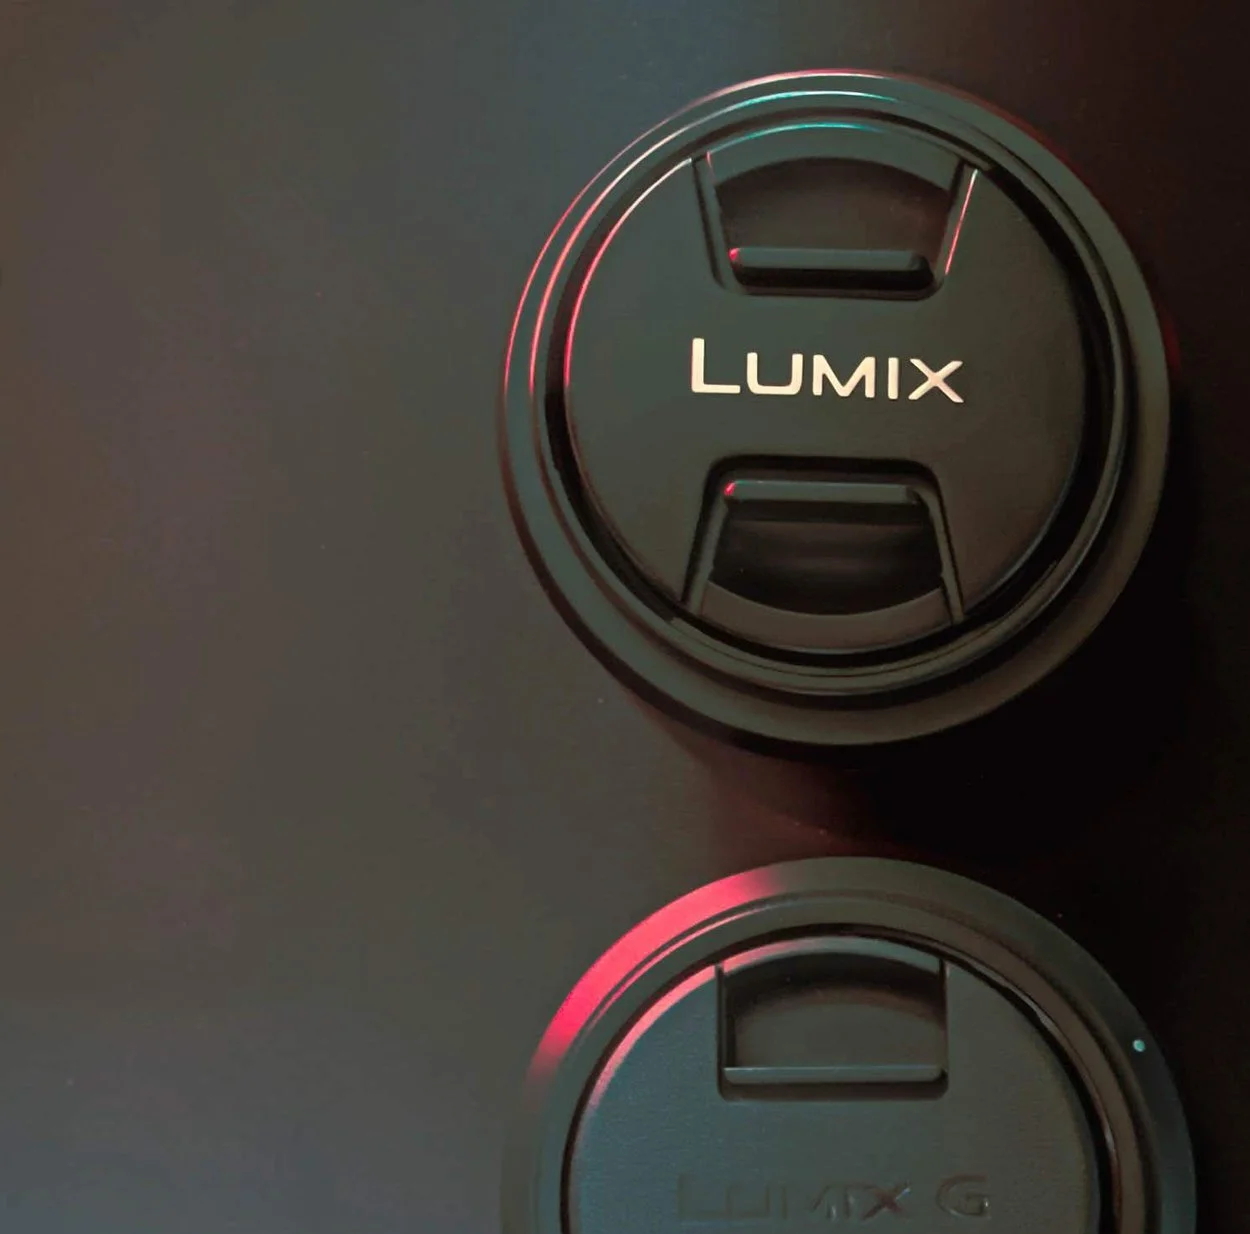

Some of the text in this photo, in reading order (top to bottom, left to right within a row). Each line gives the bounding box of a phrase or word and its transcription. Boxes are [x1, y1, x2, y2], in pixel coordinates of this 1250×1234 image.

[689, 336, 965, 404] LUMIX
[676, 1173, 990, 1222] LUMIX G
